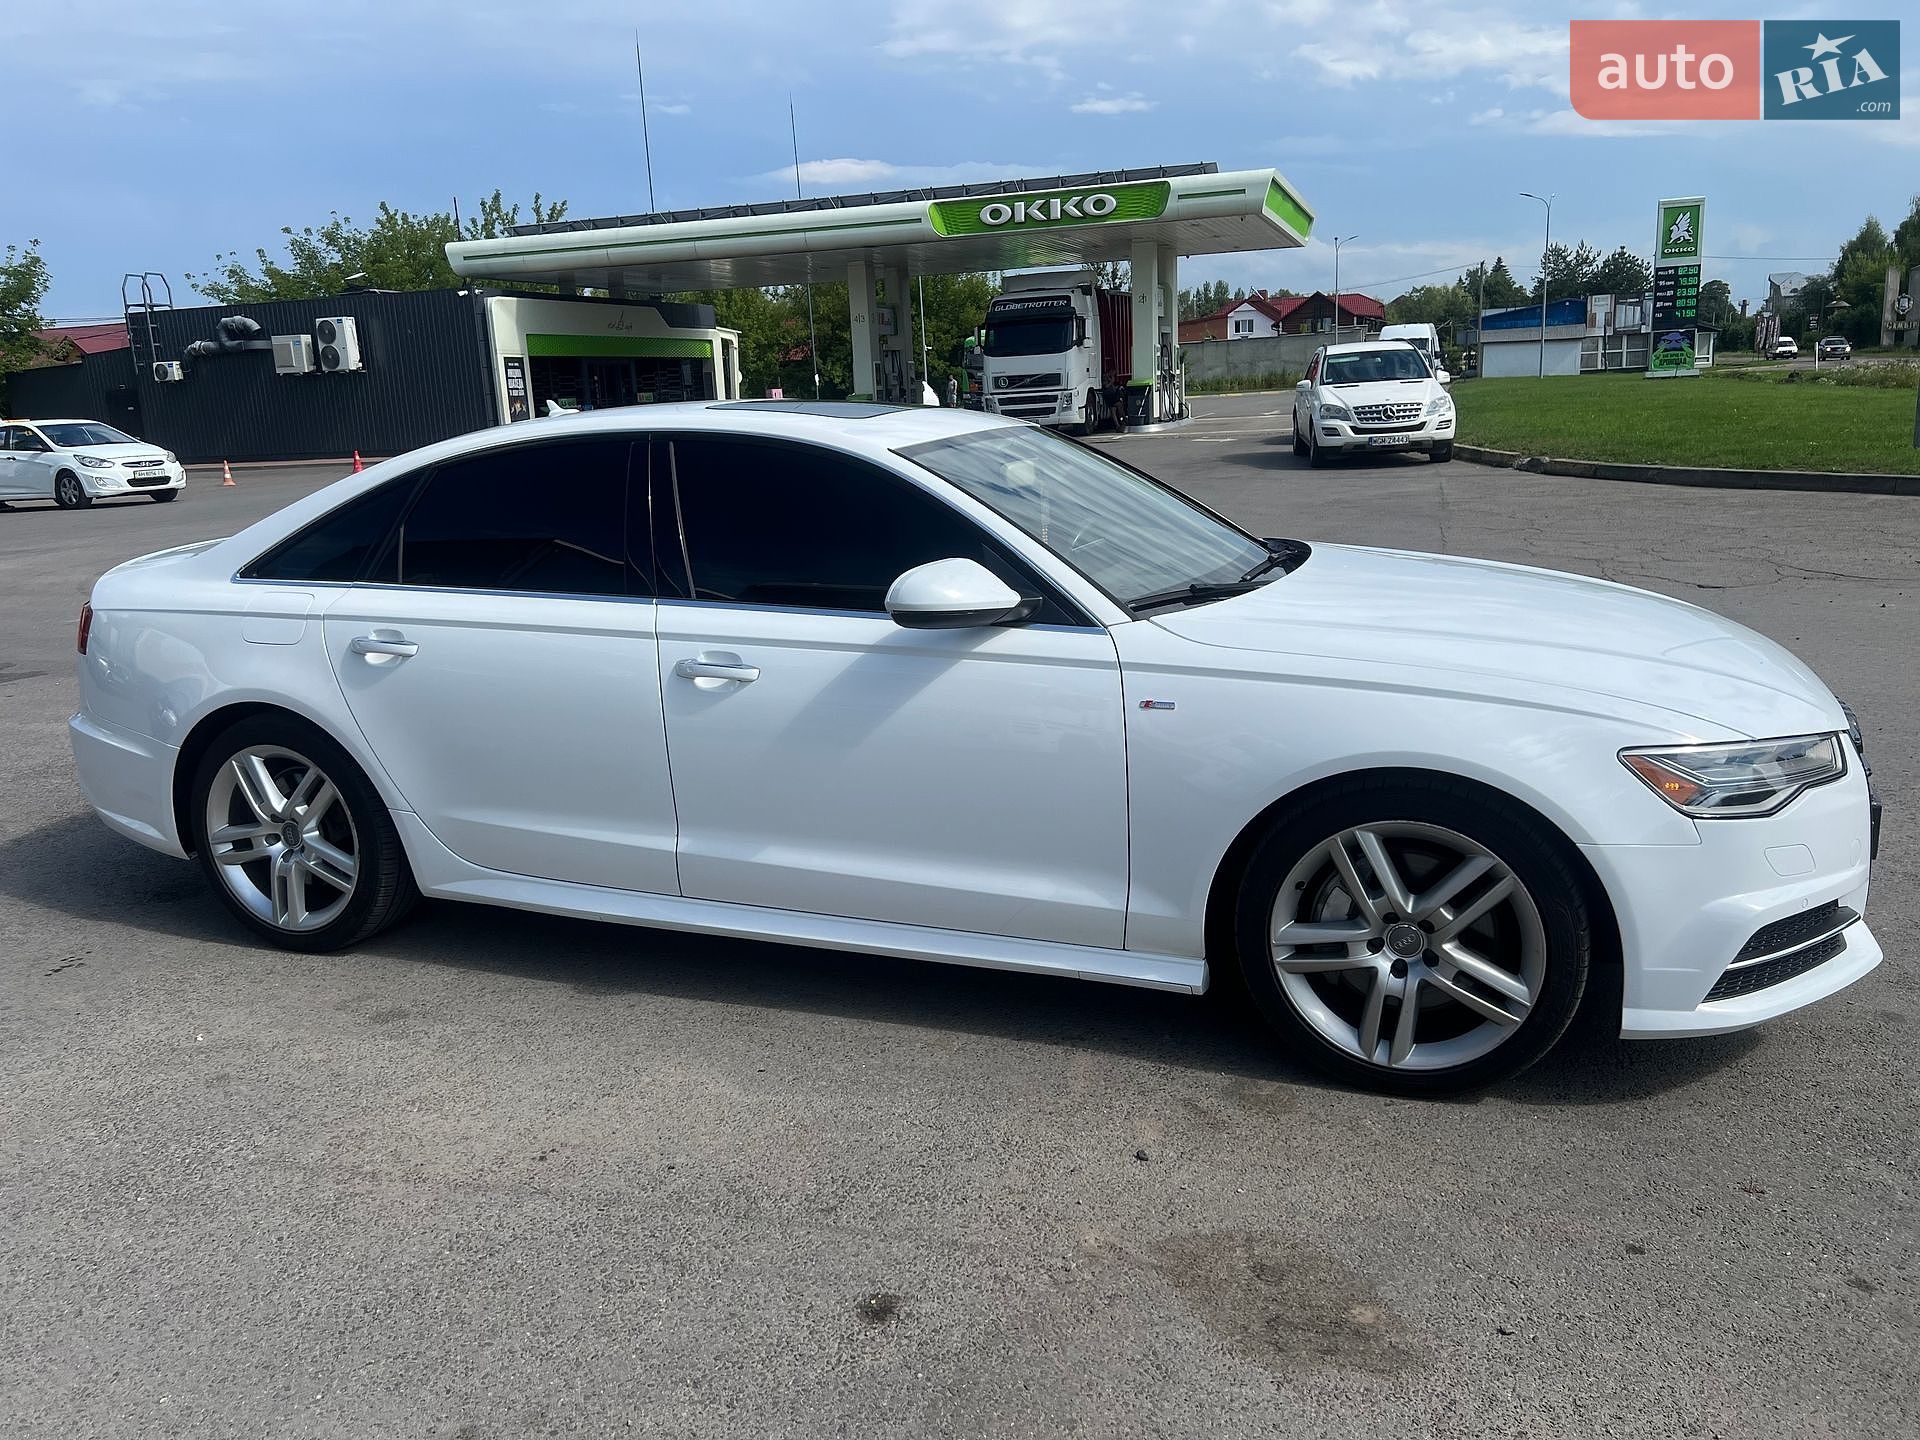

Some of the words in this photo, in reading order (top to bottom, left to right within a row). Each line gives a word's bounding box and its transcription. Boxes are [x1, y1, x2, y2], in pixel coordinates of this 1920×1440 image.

[980, 193, 1117, 226] OKKO
[1664, 246, 1695, 254] OKKO
[995, 300, 1067, 312] GLOBETROTTER
